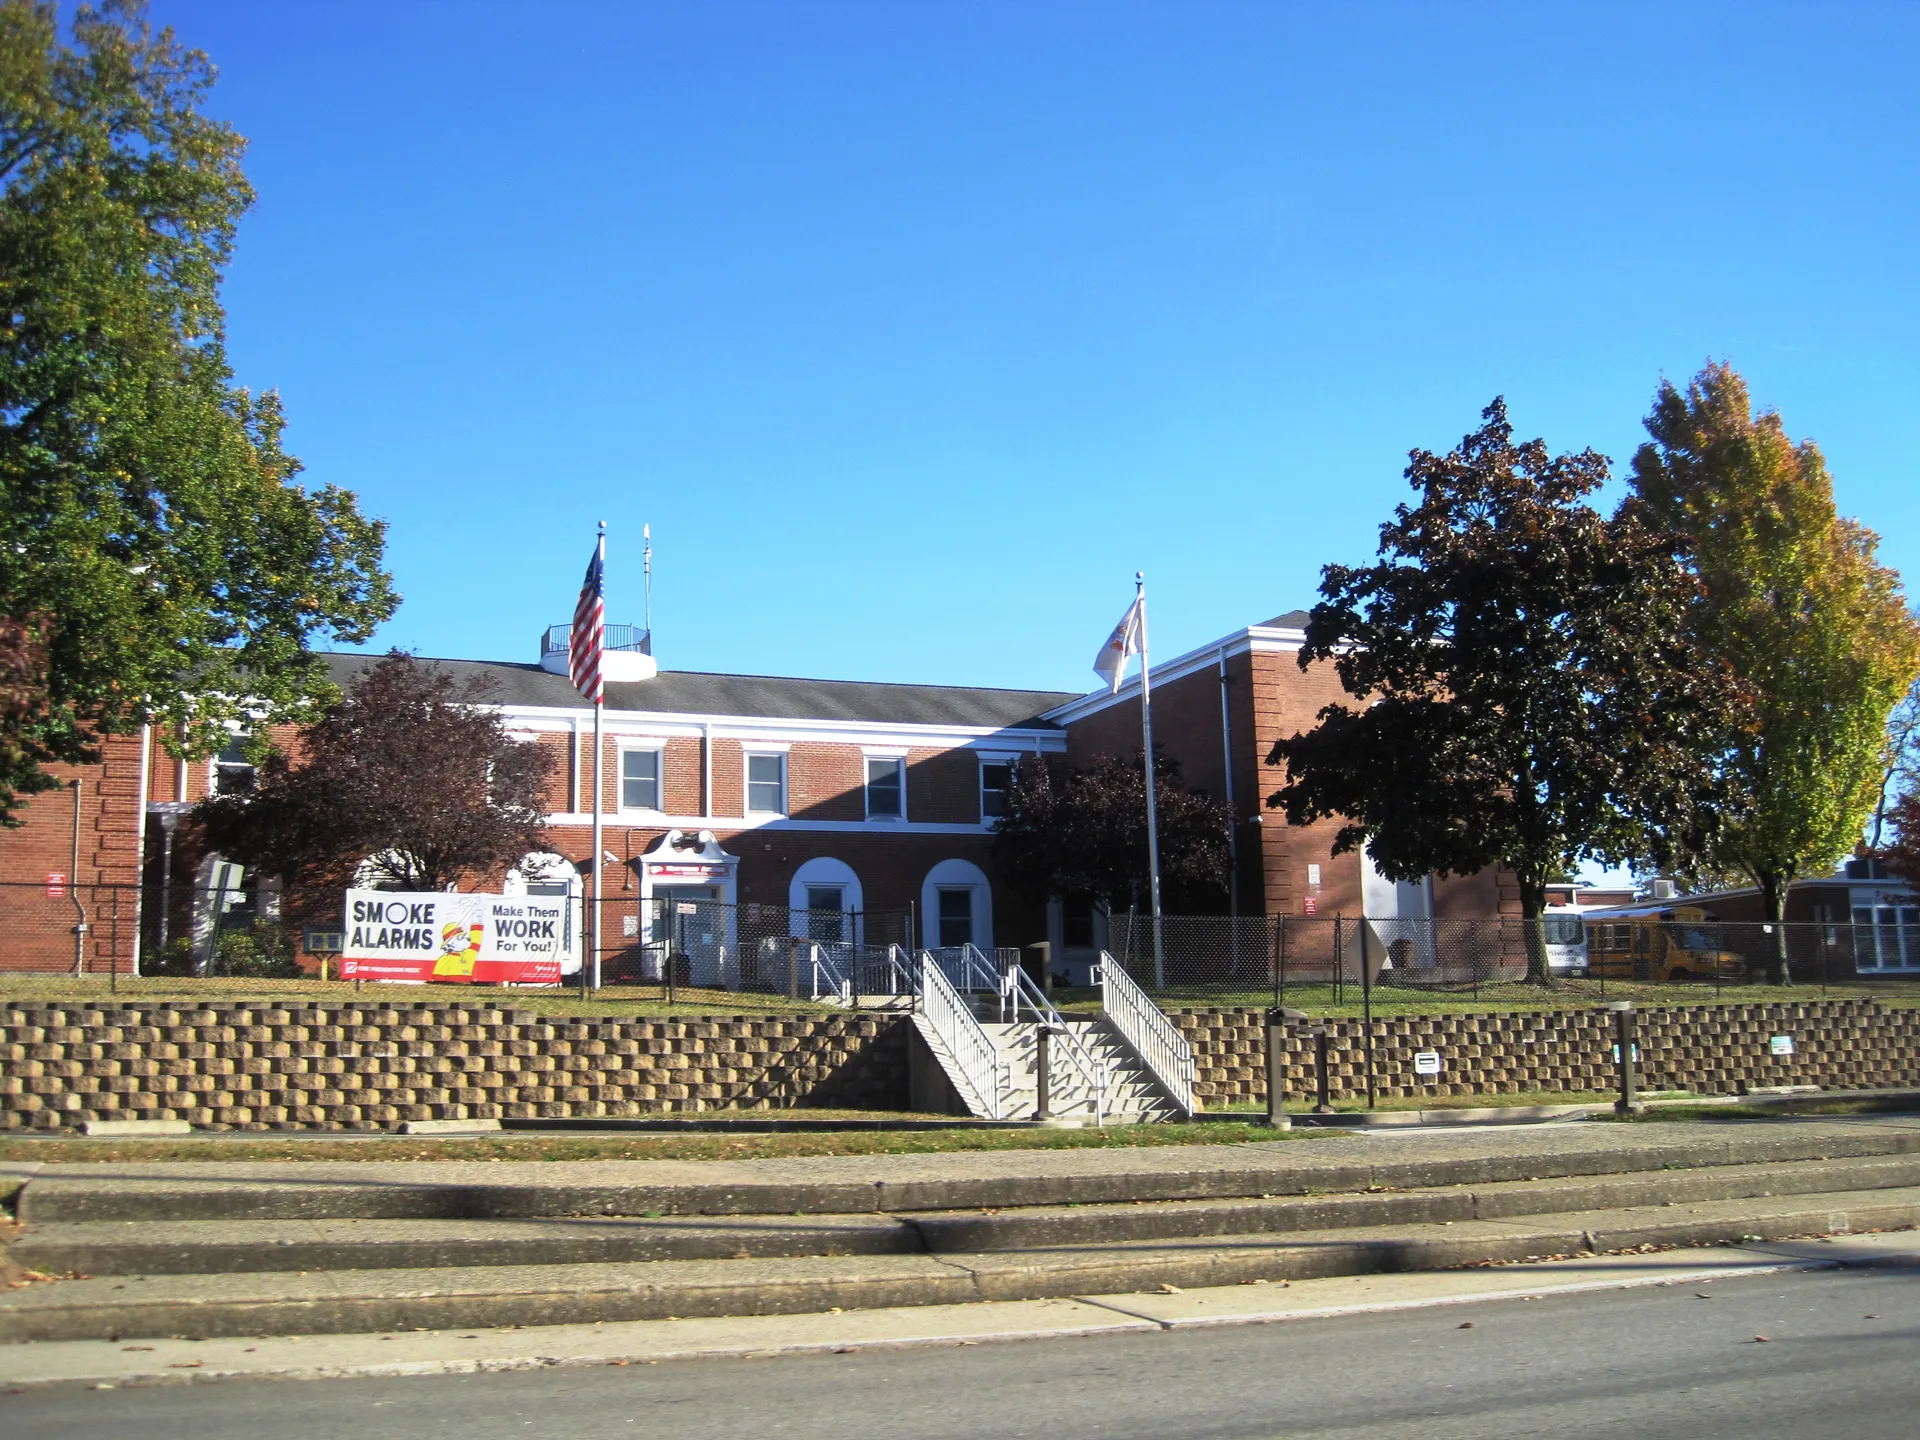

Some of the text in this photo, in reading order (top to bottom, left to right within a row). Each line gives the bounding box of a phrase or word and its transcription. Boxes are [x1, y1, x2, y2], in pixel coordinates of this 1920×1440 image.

[353, 900, 435, 925] SMOKE
[492, 905, 559, 917] Make Them
[350, 926, 433, 950] ALARMS
[495, 919, 555, 938] WORK
[496, 940, 551, 952] For You!
